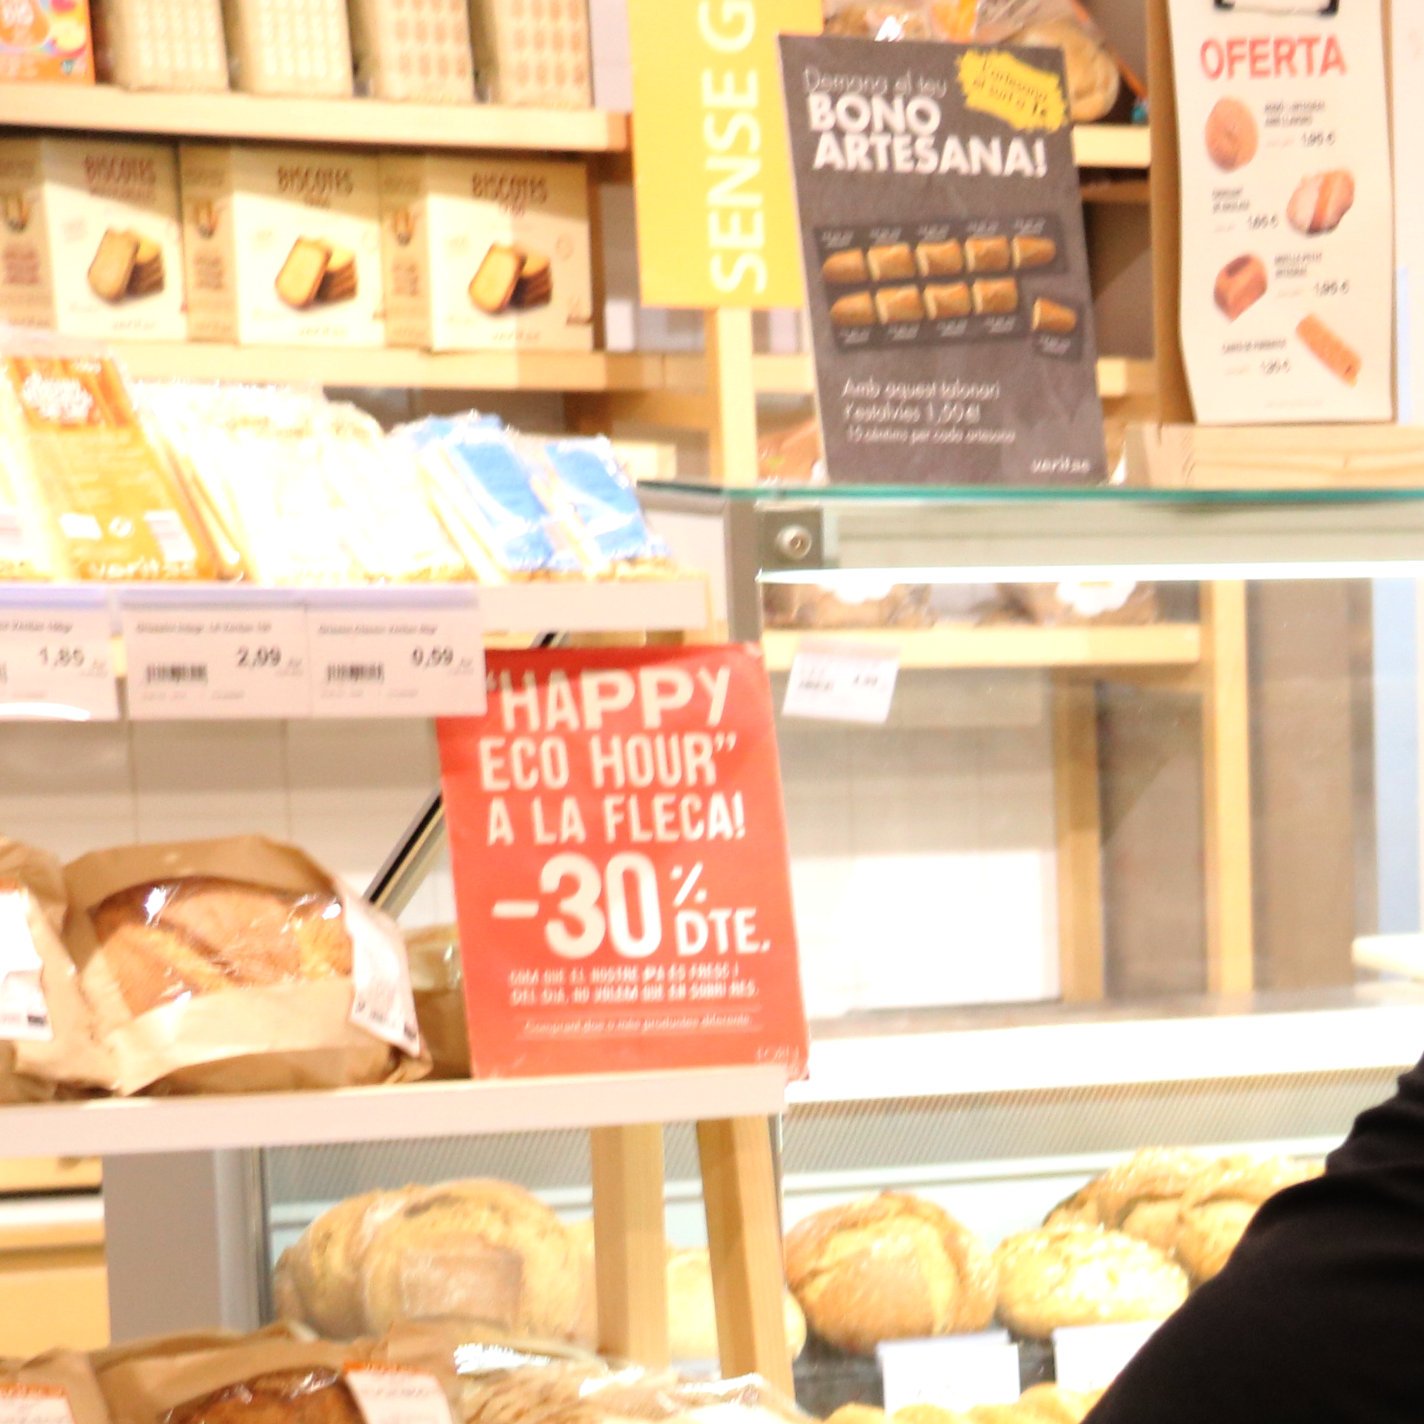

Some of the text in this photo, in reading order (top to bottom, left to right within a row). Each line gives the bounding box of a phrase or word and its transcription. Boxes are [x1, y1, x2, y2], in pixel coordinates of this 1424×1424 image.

[1199, 33, 1347, 81] OFERTA
[809, 92, 942, 135] BONO
[701, 70, 767, 293] SENSE
[813, 131, 1048, 178] ARTESANA!
[479, 736, 569, 792] ECO
[487, 791, 747, 846] A LA FLECA!
[491, 851, 771, 959] -30% DTE.
